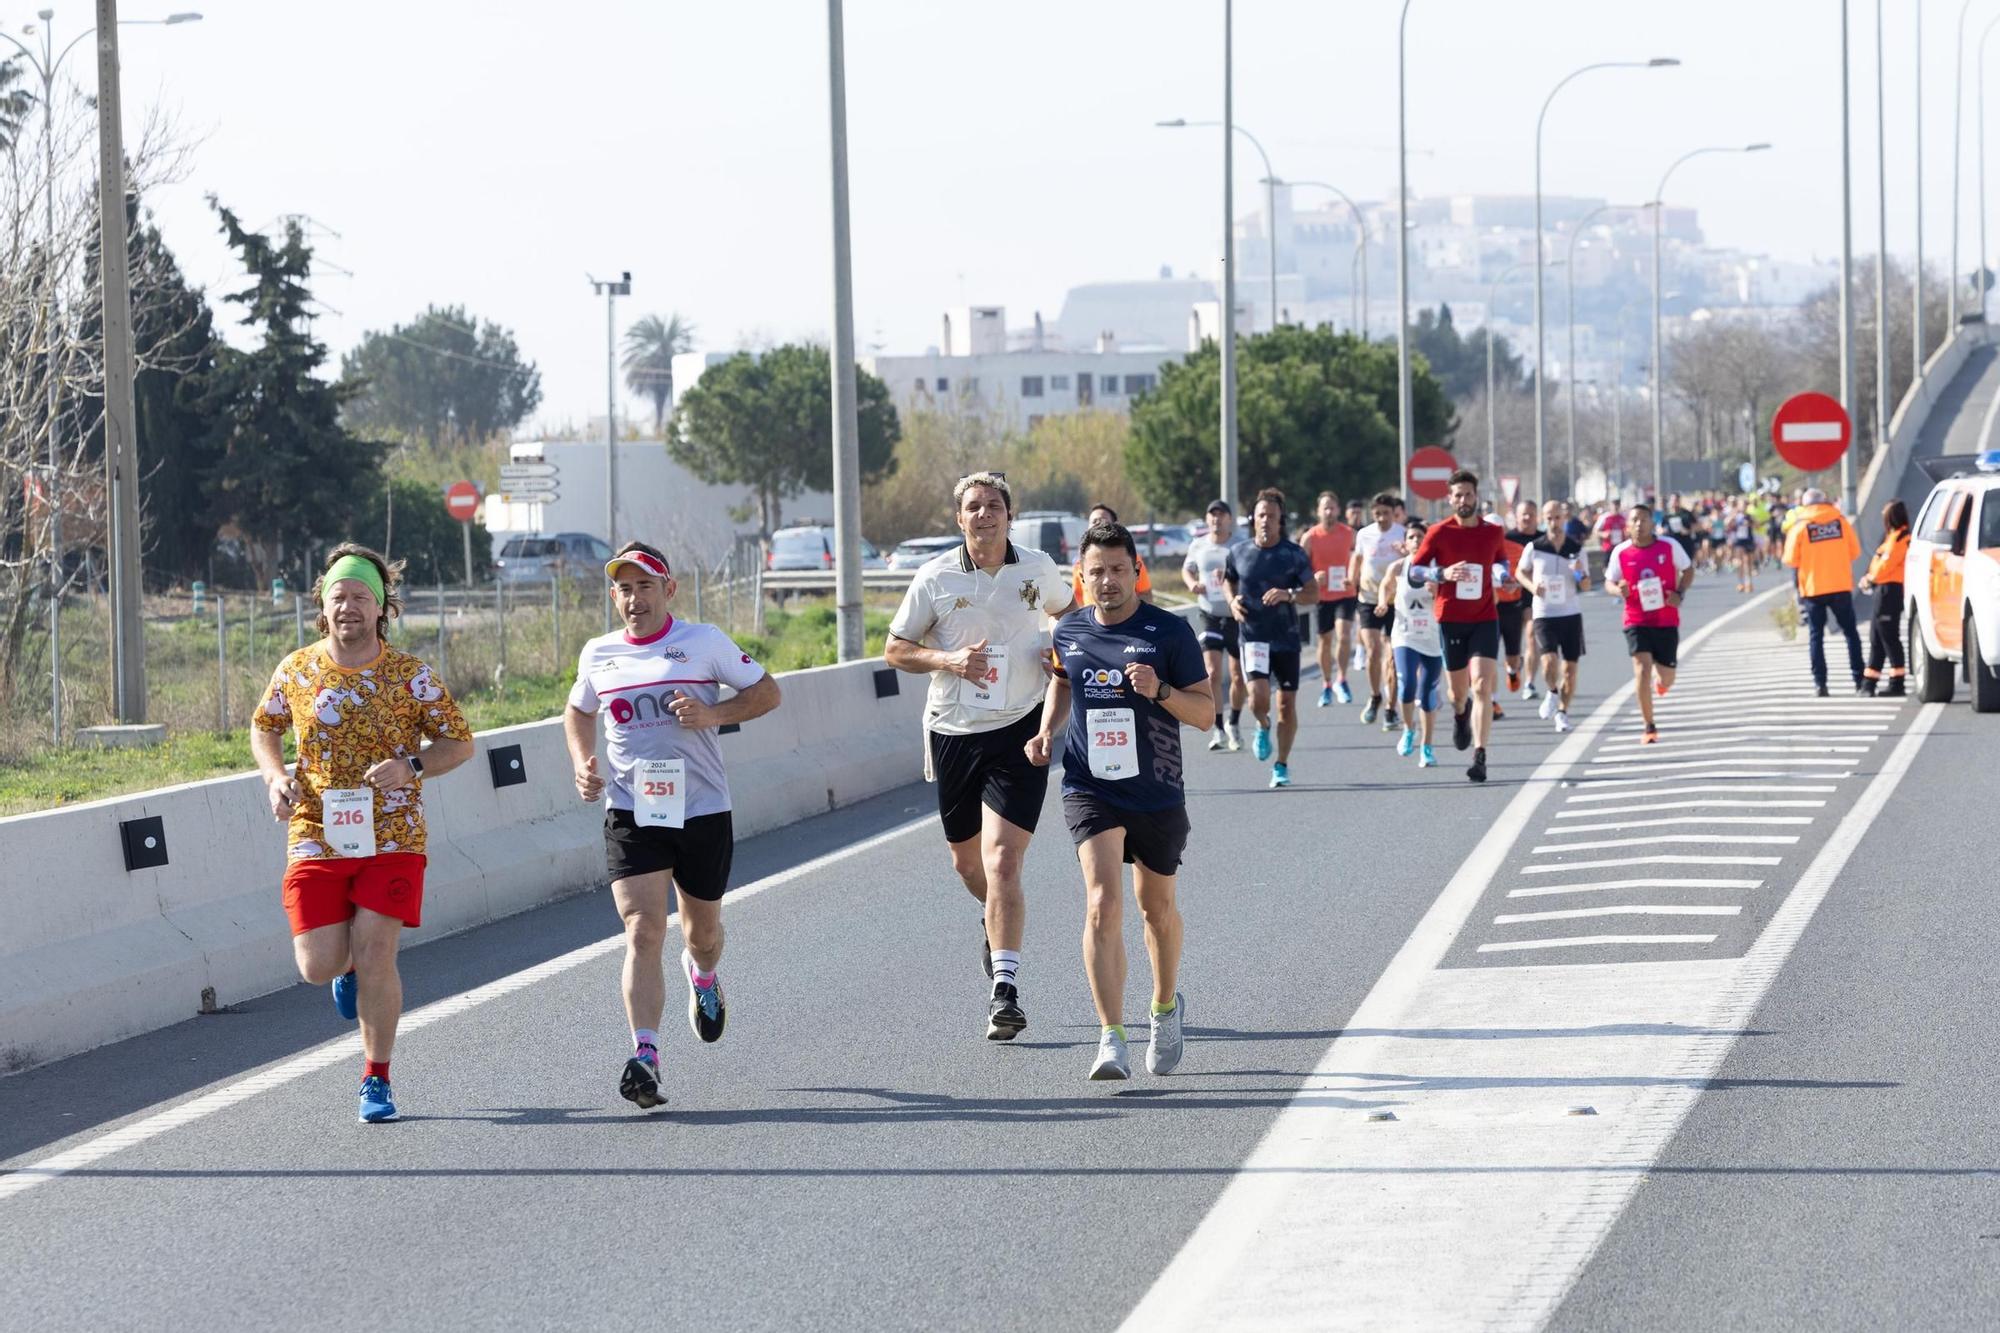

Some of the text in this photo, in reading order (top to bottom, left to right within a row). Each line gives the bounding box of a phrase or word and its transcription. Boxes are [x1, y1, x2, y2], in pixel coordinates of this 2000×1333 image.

[1136, 646, 1156, 654] mupol
[1082, 668, 1123, 687] 200
[1095, 731, 1128, 747] 253
[644, 781, 675, 796] 251
[332, 809, 364, 826] 216
